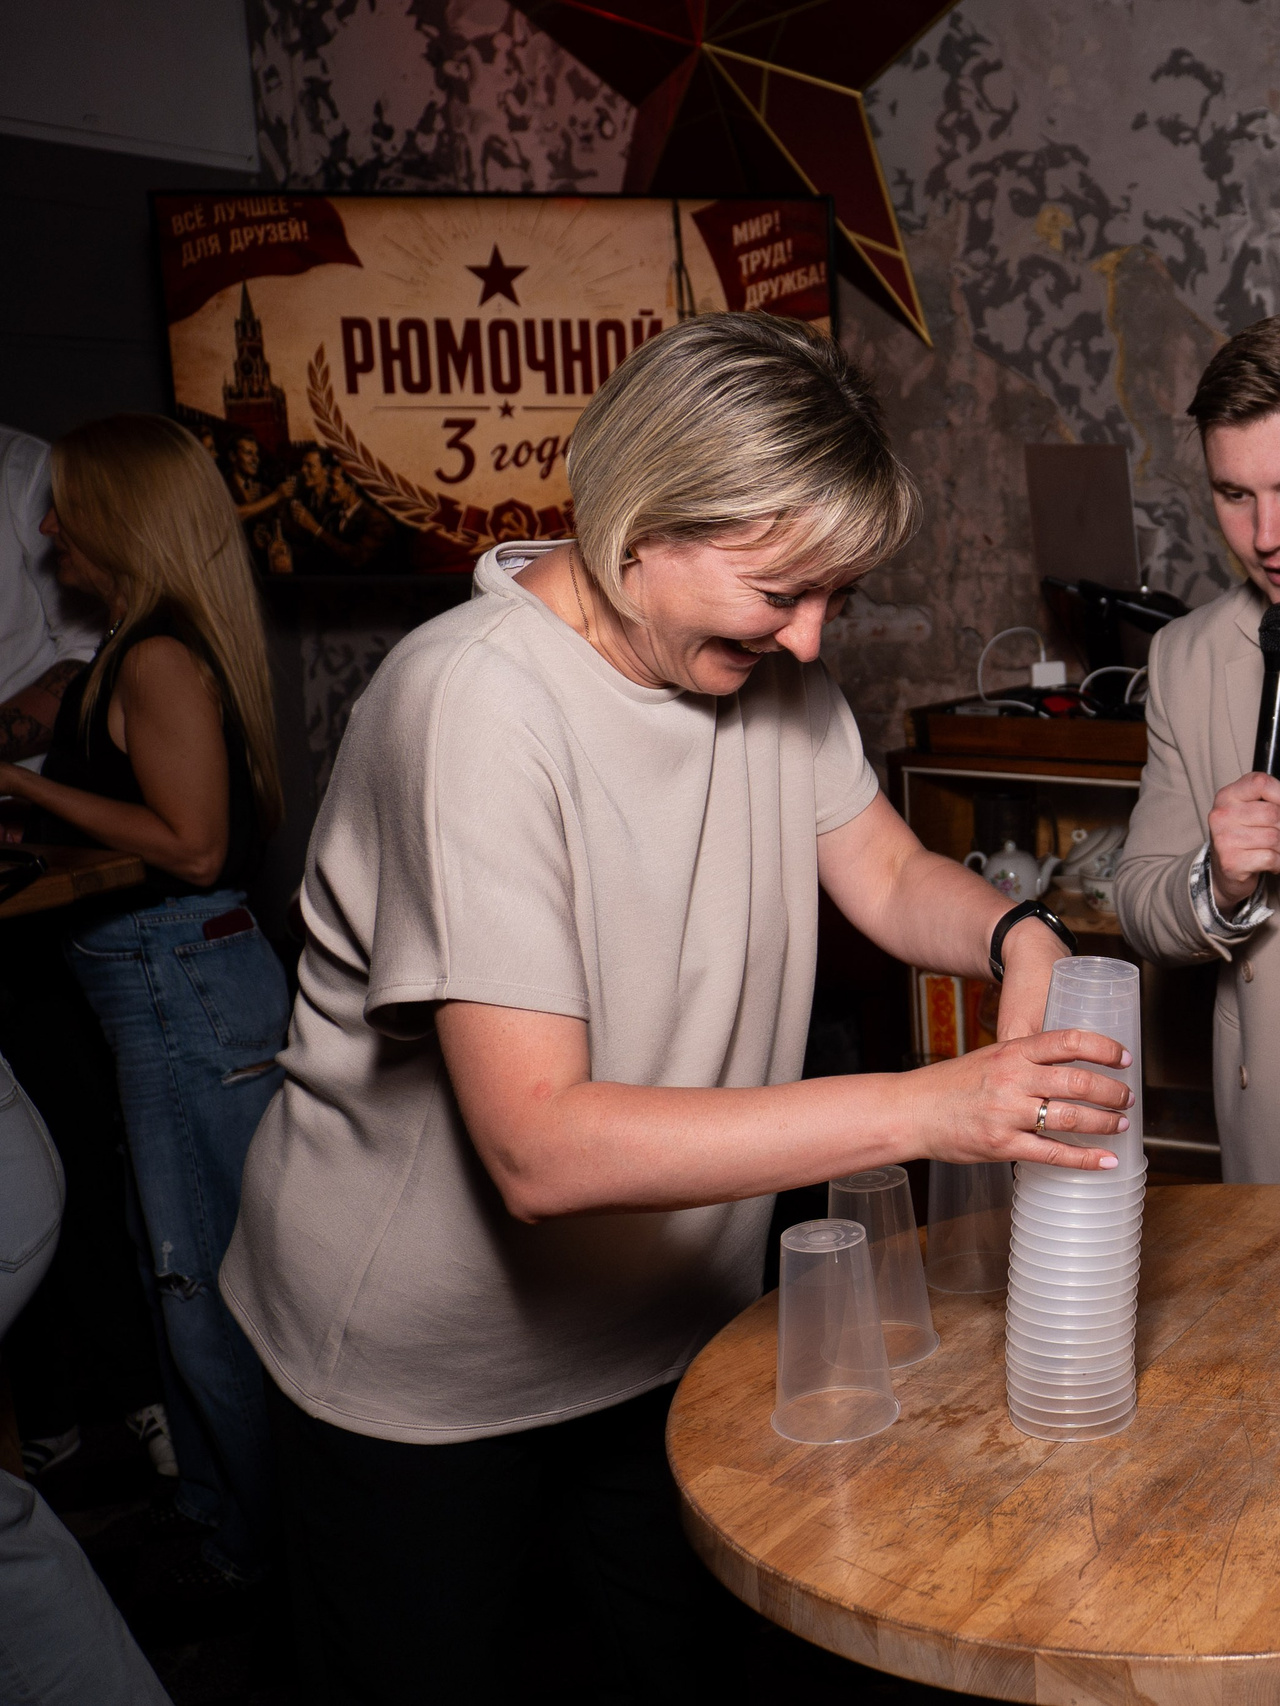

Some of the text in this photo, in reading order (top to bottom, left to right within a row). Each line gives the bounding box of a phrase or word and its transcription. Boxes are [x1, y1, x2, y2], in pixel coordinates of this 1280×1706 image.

[171, 202, 207, 236] ВСЁ
[213, 196, 290, 225] ЛУЧШЕЕ
[731, 209, 781, 248] МИР!
[181, 216, 310, 270] ДЛЯ ДРУЗЕЙ!
[737, 238, 794, 278] ТРУД!
[744, 261, 827, 310] ДРУЖБА!
[435, 418, 476, 484] 3
